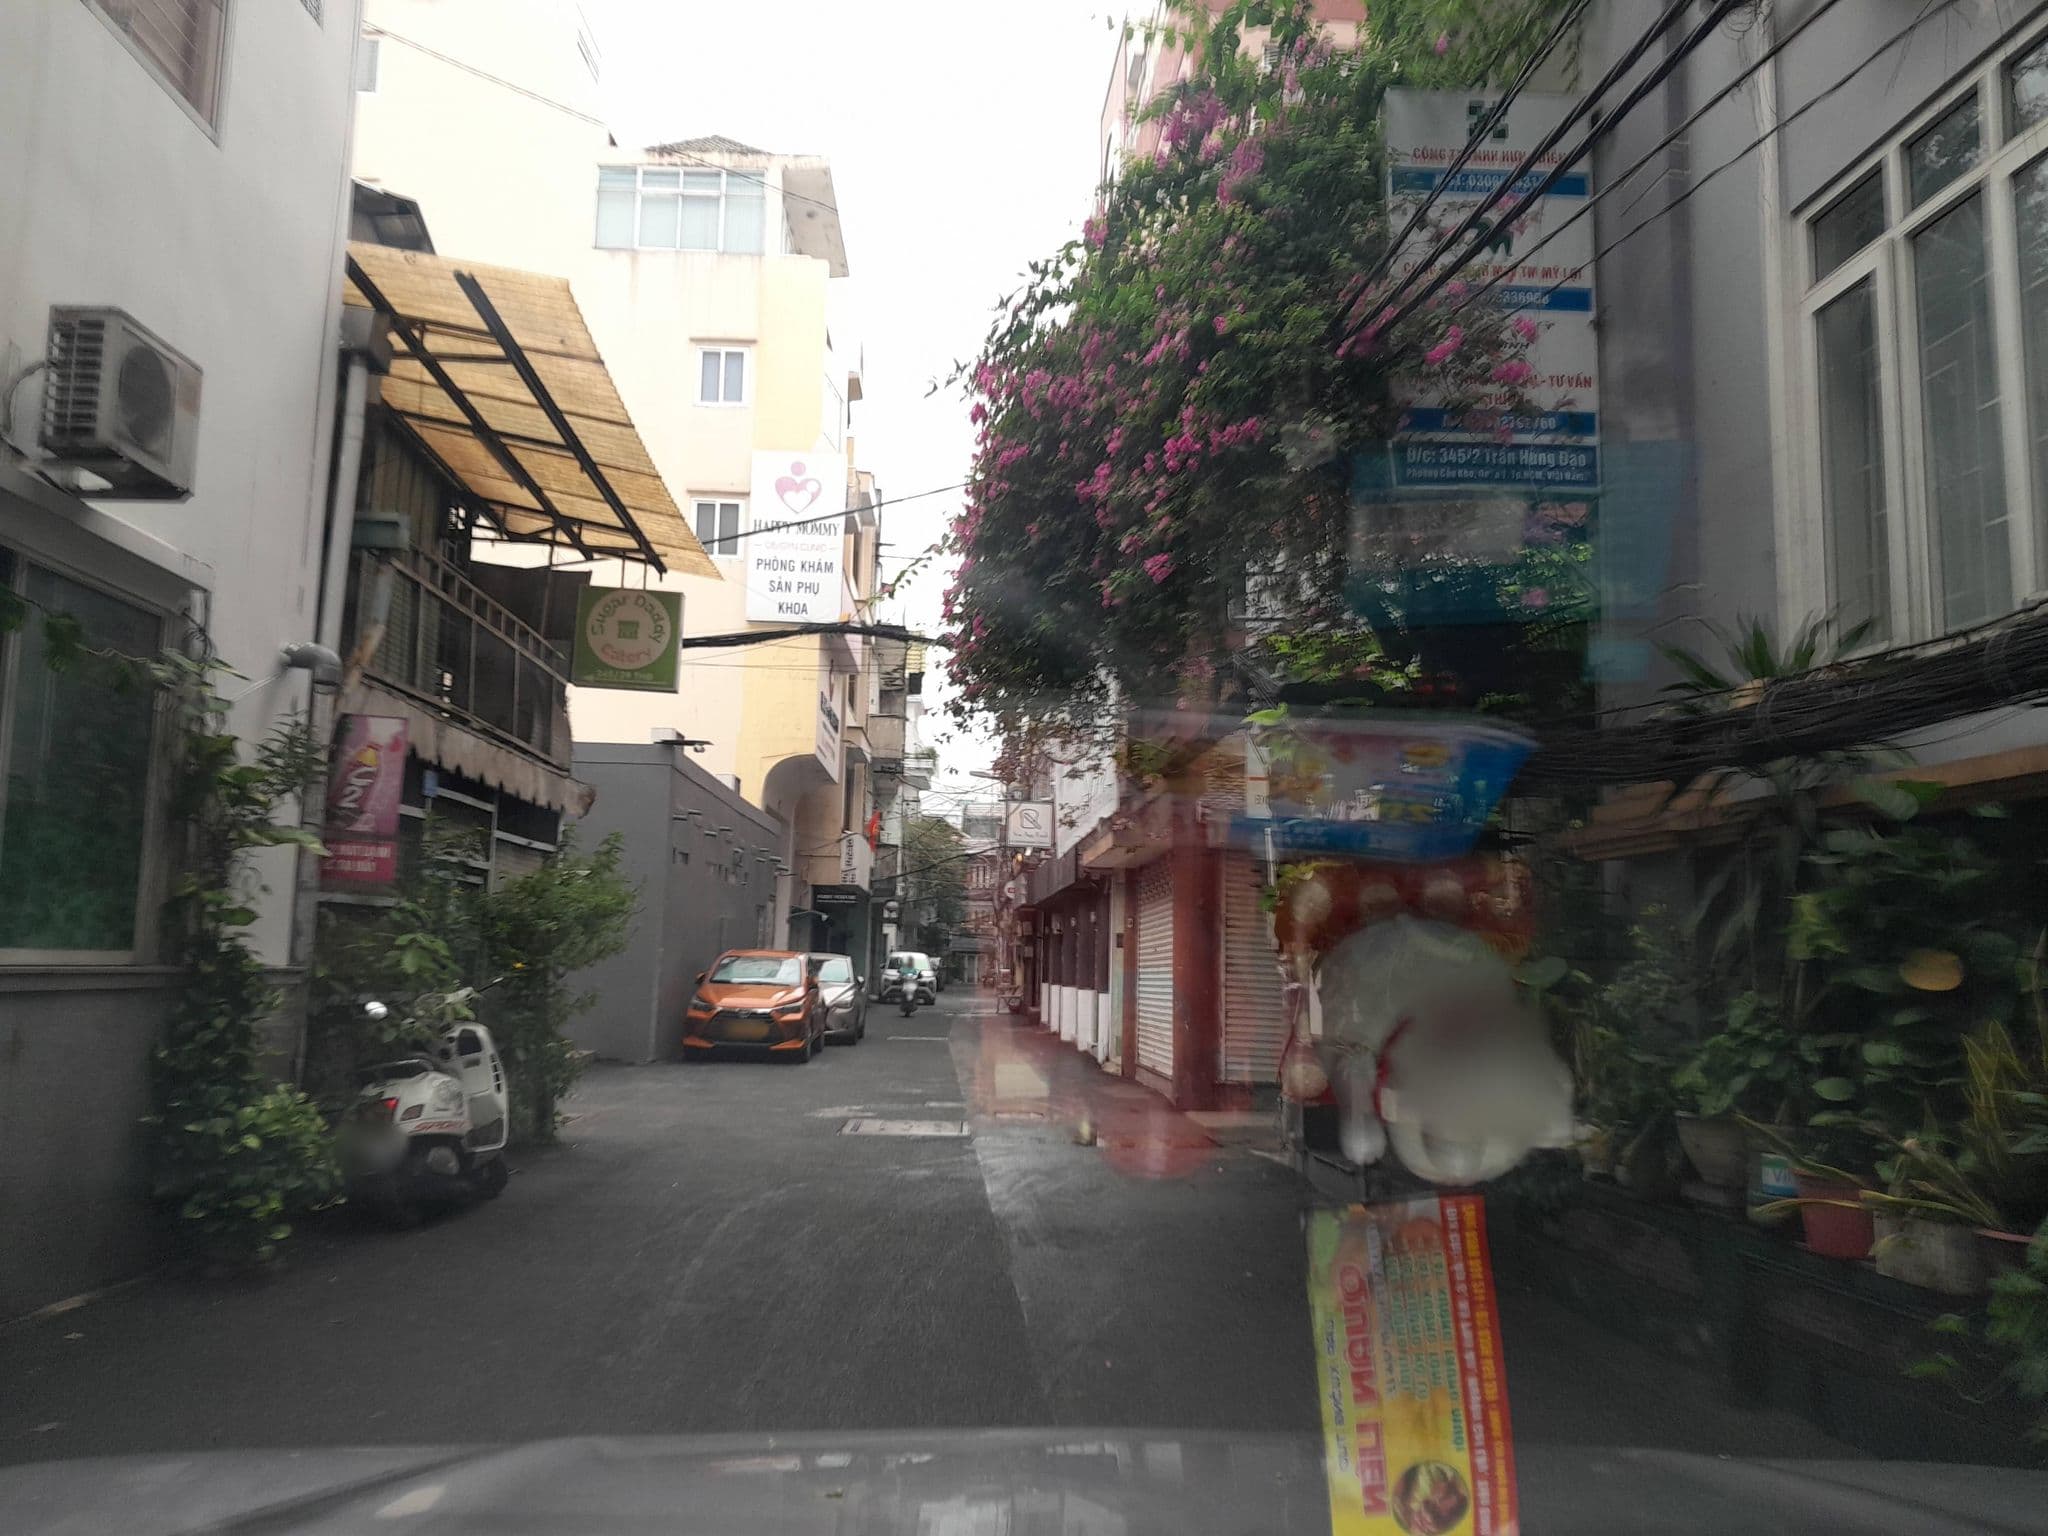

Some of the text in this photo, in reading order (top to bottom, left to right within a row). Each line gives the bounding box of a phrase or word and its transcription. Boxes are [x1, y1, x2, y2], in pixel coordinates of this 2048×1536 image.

[753, 519, 840, 536] HAPPY MOMMY
[756, 556, 834, 574] PHÒNG KHÁM
[769, 577, 820, 595] SẢN PHỤ
[778, 601, 808, 615] KHOA
